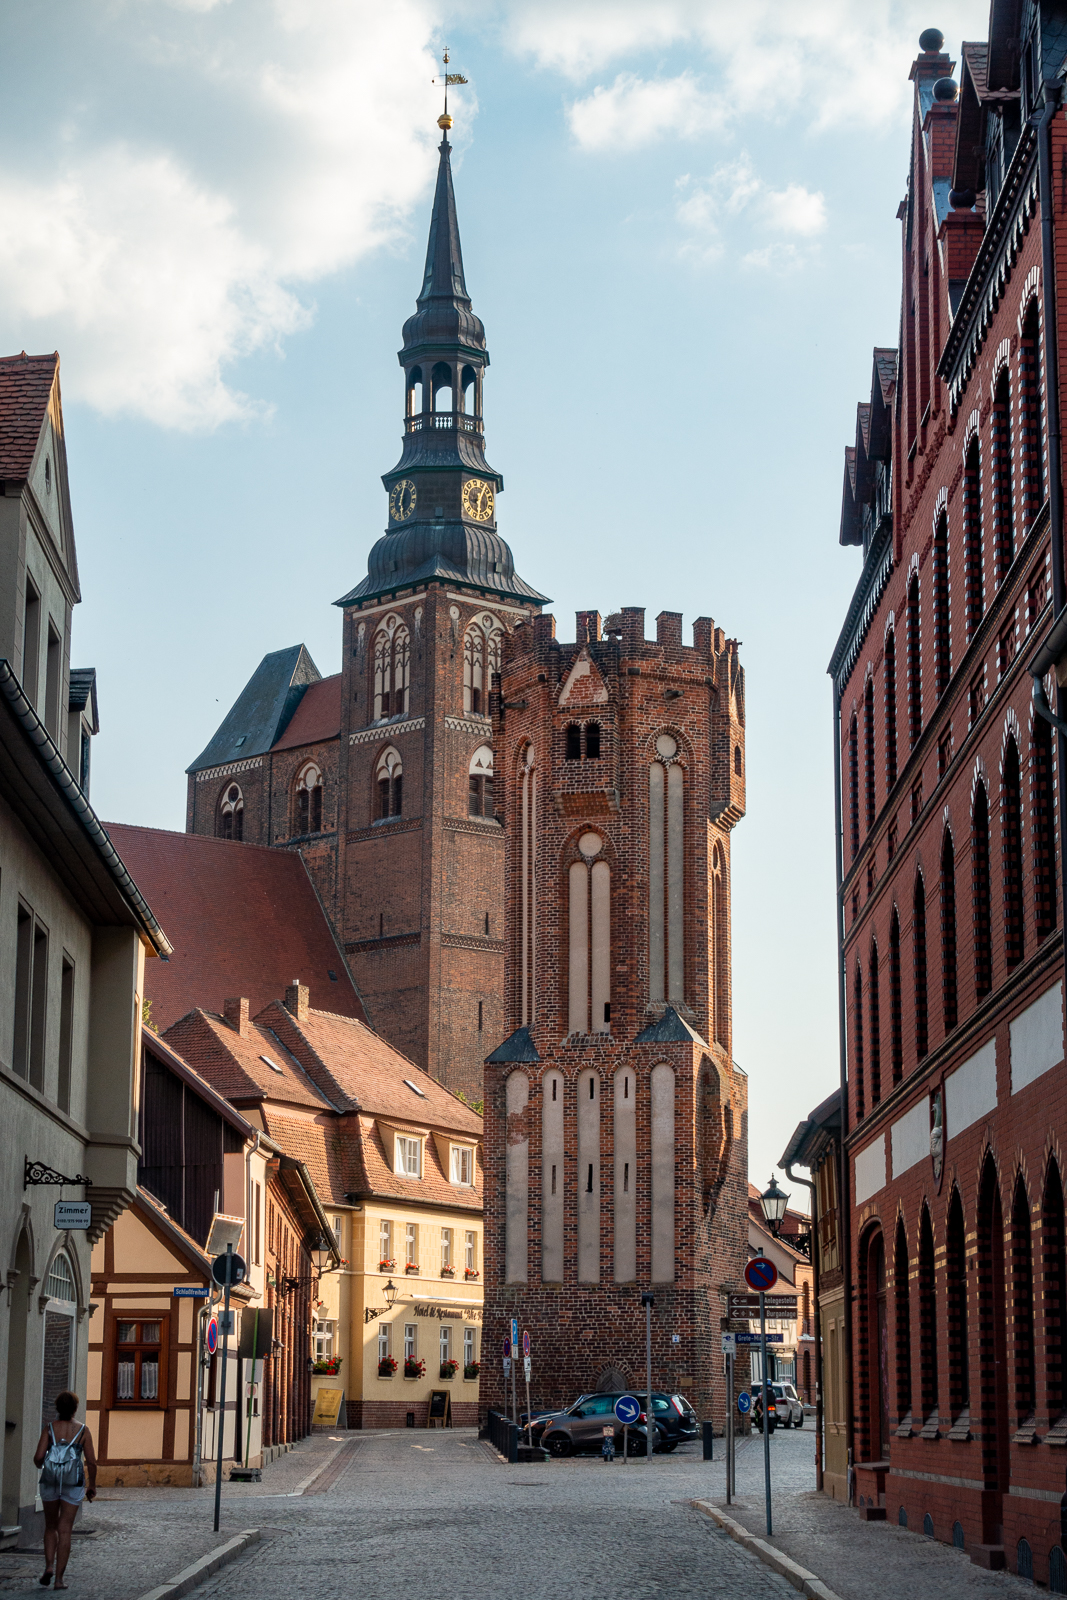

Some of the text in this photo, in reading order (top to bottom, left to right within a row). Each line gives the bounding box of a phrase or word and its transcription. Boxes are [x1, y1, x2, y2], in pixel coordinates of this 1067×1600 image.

[58, 1206, 88, 1214] Zimmer
[764, 1296, 796, 1305] Anlegestelle
[413, 1304, 430, 1317] Hotel
[766, 1310, 796, 1318] Burganlage
